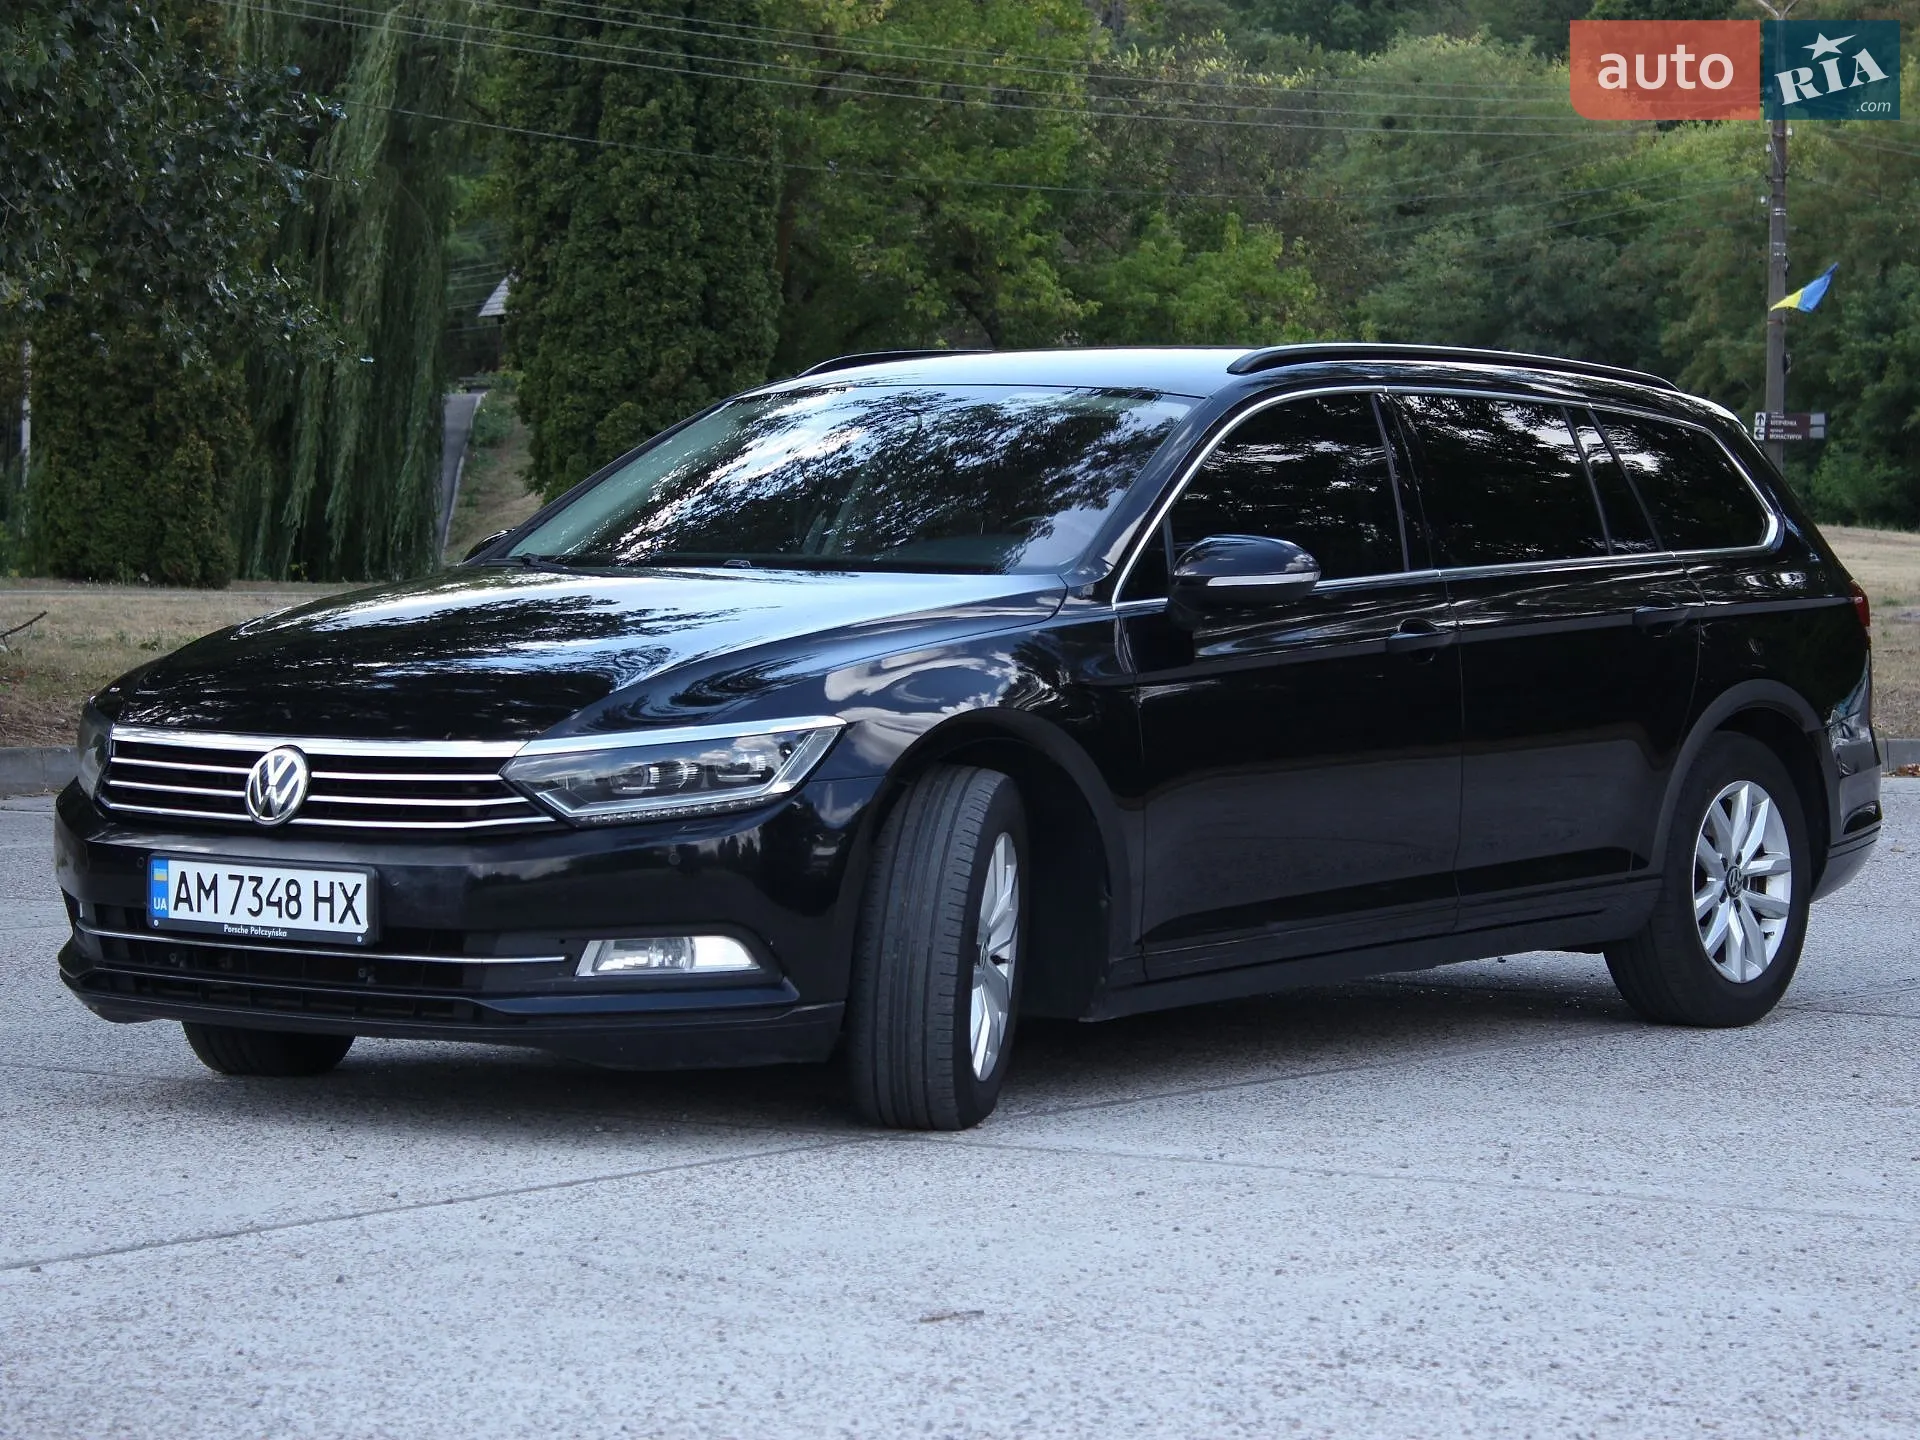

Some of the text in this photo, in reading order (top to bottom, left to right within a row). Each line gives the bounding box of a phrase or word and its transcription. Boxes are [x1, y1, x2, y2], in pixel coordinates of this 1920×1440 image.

[153, 897, 168, 911] UA
[173, 870, 362, 925] AM 7348 HX
[223, 923, 249, 935] Porsche
